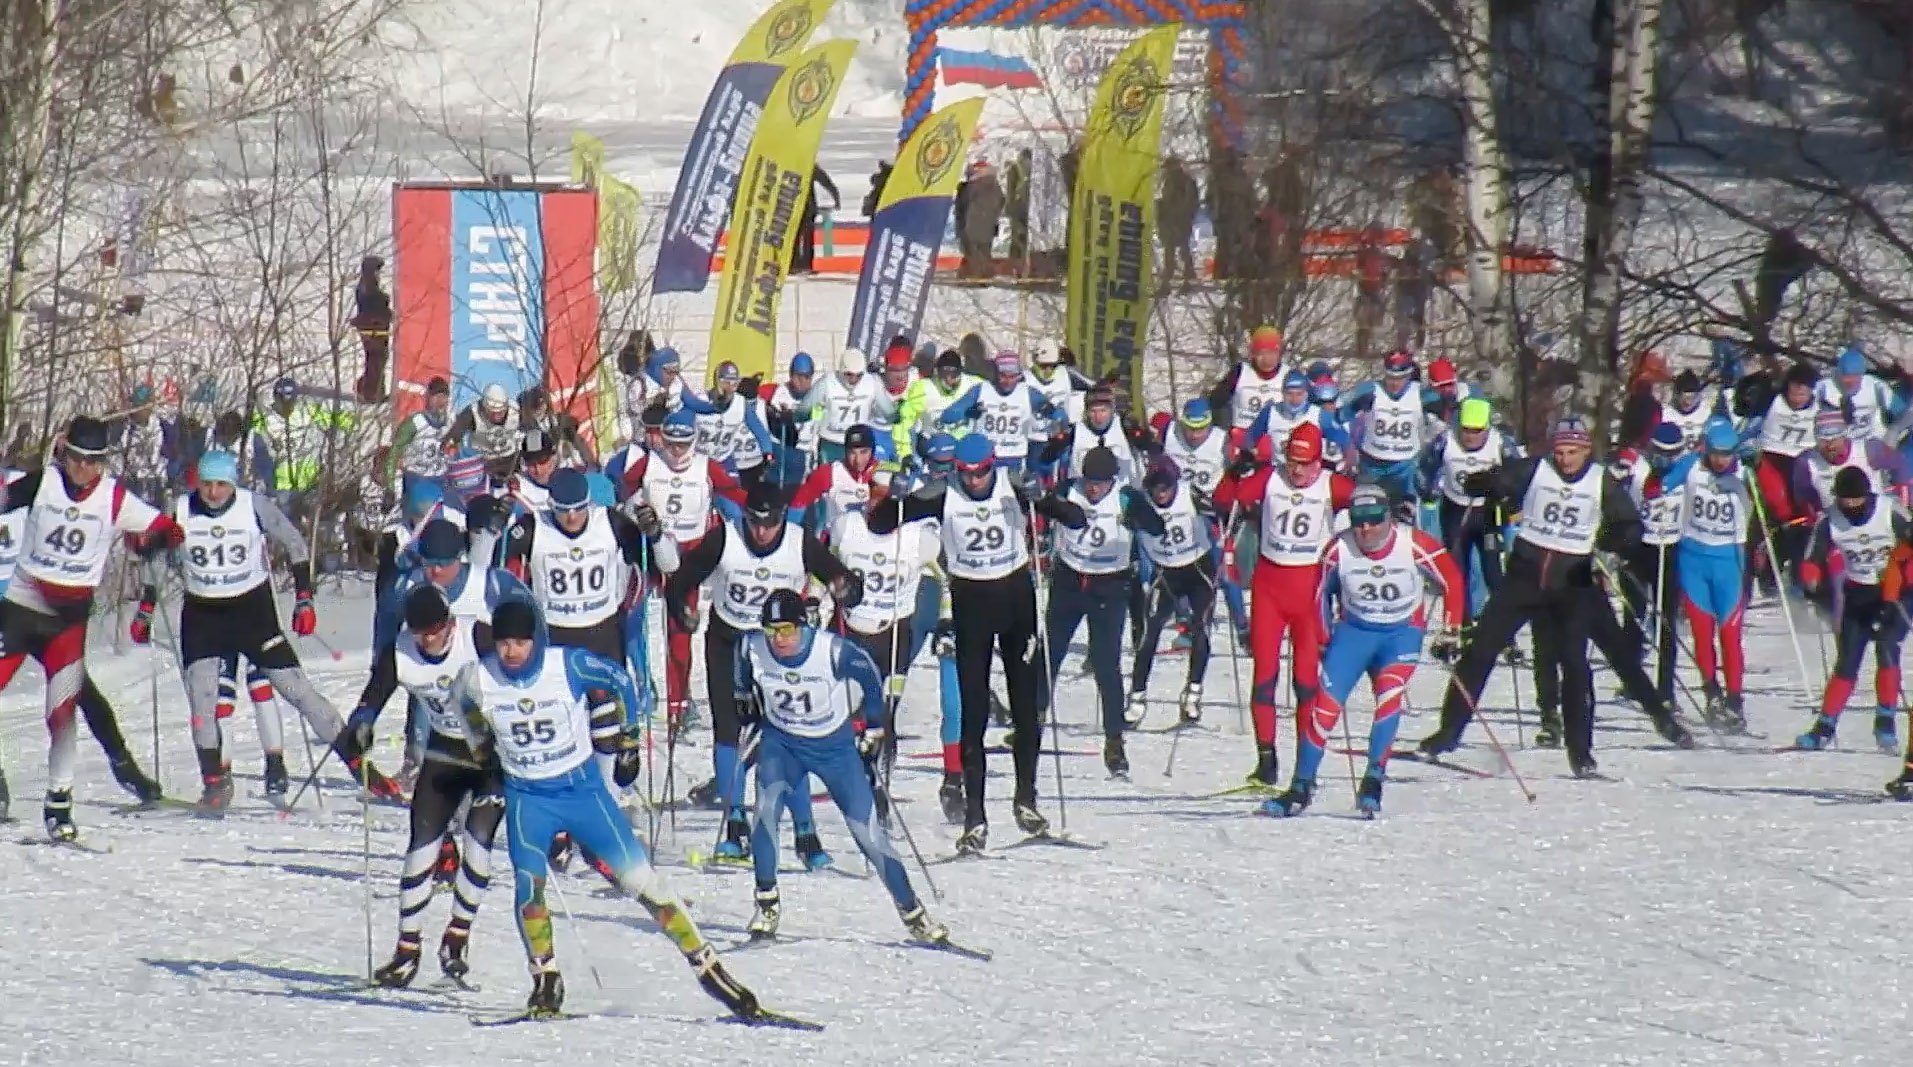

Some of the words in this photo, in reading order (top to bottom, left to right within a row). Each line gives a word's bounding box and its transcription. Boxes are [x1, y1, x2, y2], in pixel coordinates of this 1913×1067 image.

[468, 226, 527, 369] СТАРТ
[838, 405, 860, 422] 71
[984, 414, 1020, 434] 805
[1374, 419, 1412, 440] 848
[1780, 424, 1807, 443] 77
[665, 493, 683, 514] 5
[1543, 502, 1580, 527] 65
[1693, 495, 1735, 524] 809
[1275, 509, 1311, 538] 16
[44, 524, 86, 555] 49
[964, 525, 1004, 551] 29
[190, 543, 247, 567] 813
[549, 565, 605, 595] 810
[1359, 582, 1400, 601] 30
[728, 582, 768, 606] 82
[773, 689, 812, 713] 21
[511, 718, 556, 748] 55
